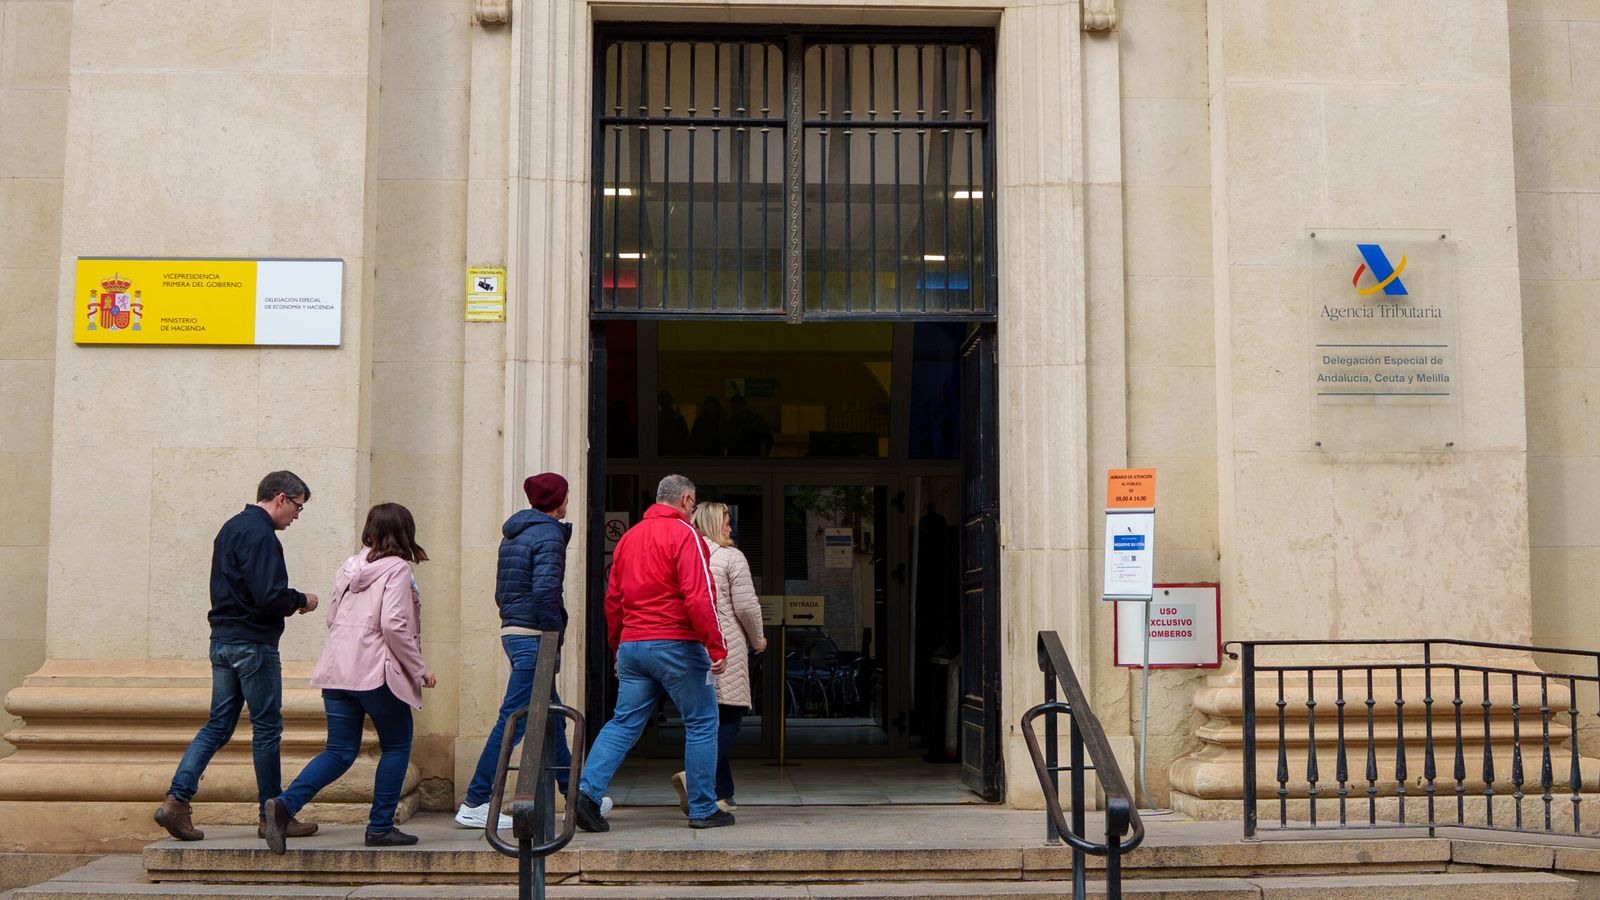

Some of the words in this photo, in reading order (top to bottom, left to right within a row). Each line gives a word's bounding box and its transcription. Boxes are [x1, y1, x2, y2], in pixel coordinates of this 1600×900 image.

[1320, 304, 1374, 321] Agencia
[1377, 304, 1442, 318] Tributaria
[1322, 355, 1381, 366] Delegación
[1384, 356, 1427, 366] Especial
[1430, 356, 1443, 365] de
[1317, 374, 1372, 383] Andalucía,
[1375, 374, 1405, 382] Ceuta
[1408, 375, 1414, 384] y
[1416, 374, 1450, 382] Melilla
